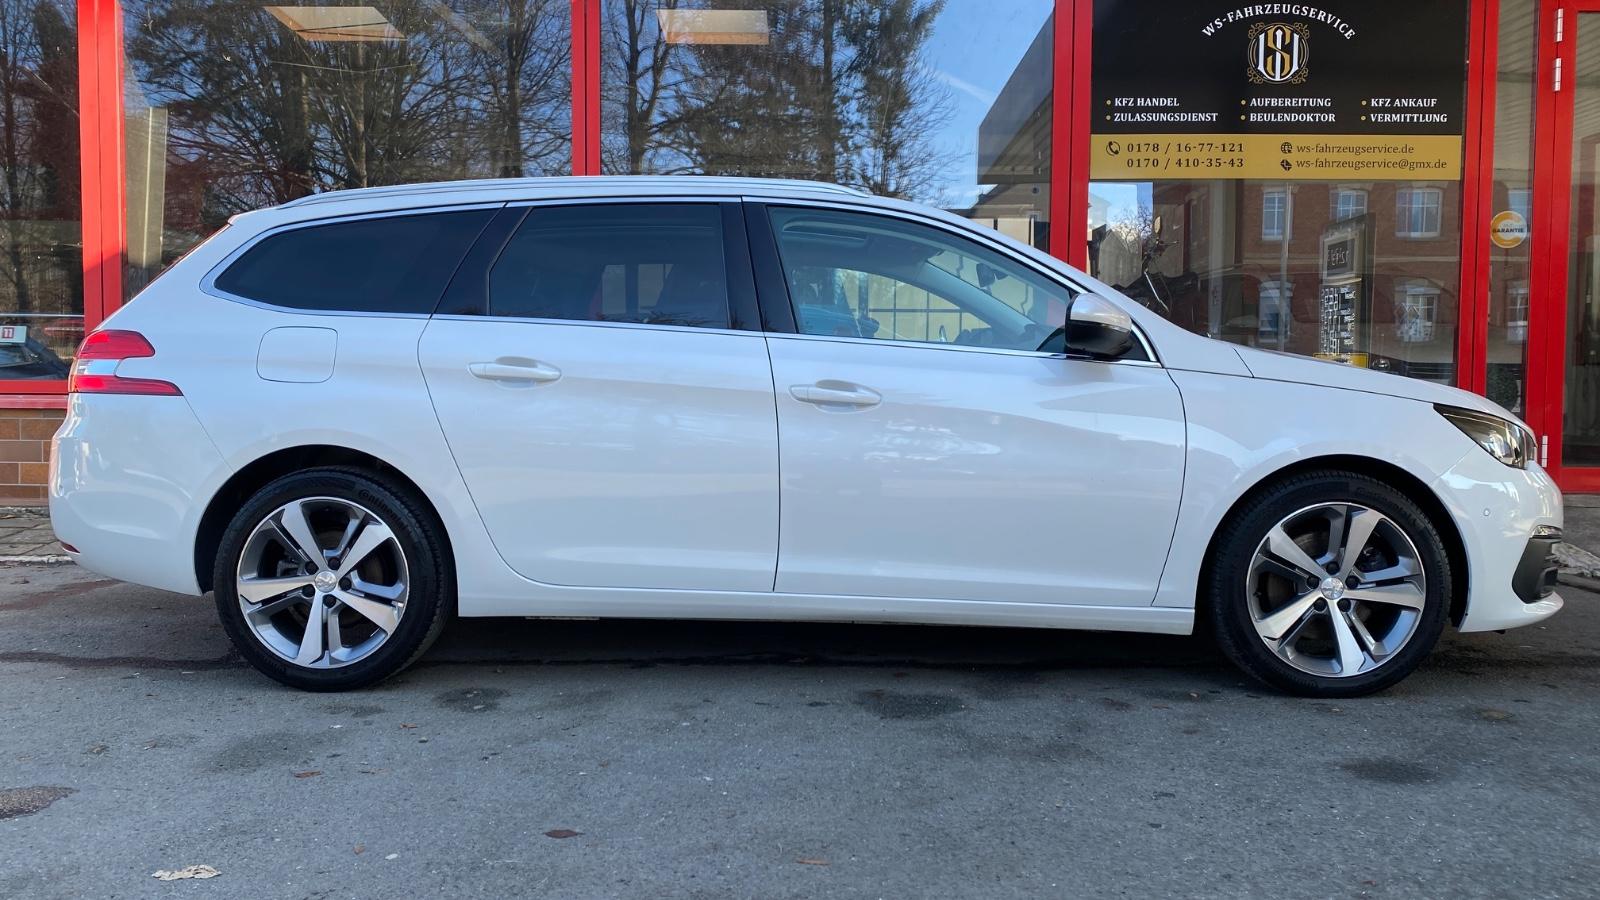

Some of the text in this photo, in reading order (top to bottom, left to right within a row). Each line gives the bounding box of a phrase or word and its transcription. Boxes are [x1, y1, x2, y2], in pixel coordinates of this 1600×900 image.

[1202, 4, 1355, 40] WS-FAHRZEUGSERVICE
[1114, 97, 1180, 107] KFZ HANDEL
[1249, 98, 1331, 107] AUFBEREITUNG
[1371, 98, 1437, 107] KFZ ANKAUF
[1113, 112, 1218, 122] ZULASSUNGSDIENST
[1249, 112, 1336, 122] BEULENDOKTOR
[1370, 113, 1448, 123] VERMITTLUNG
[1127, 142, 1244, 155] 0178 / 16-77-121
[1296, 143, 1414, 155] ws-fahrzeugservice.de
[1127, 158, 1244, 170] 0170 / 410-35-43
[1295, 158, 1447, 170] ws-fahrzeugservice@gmx.de
